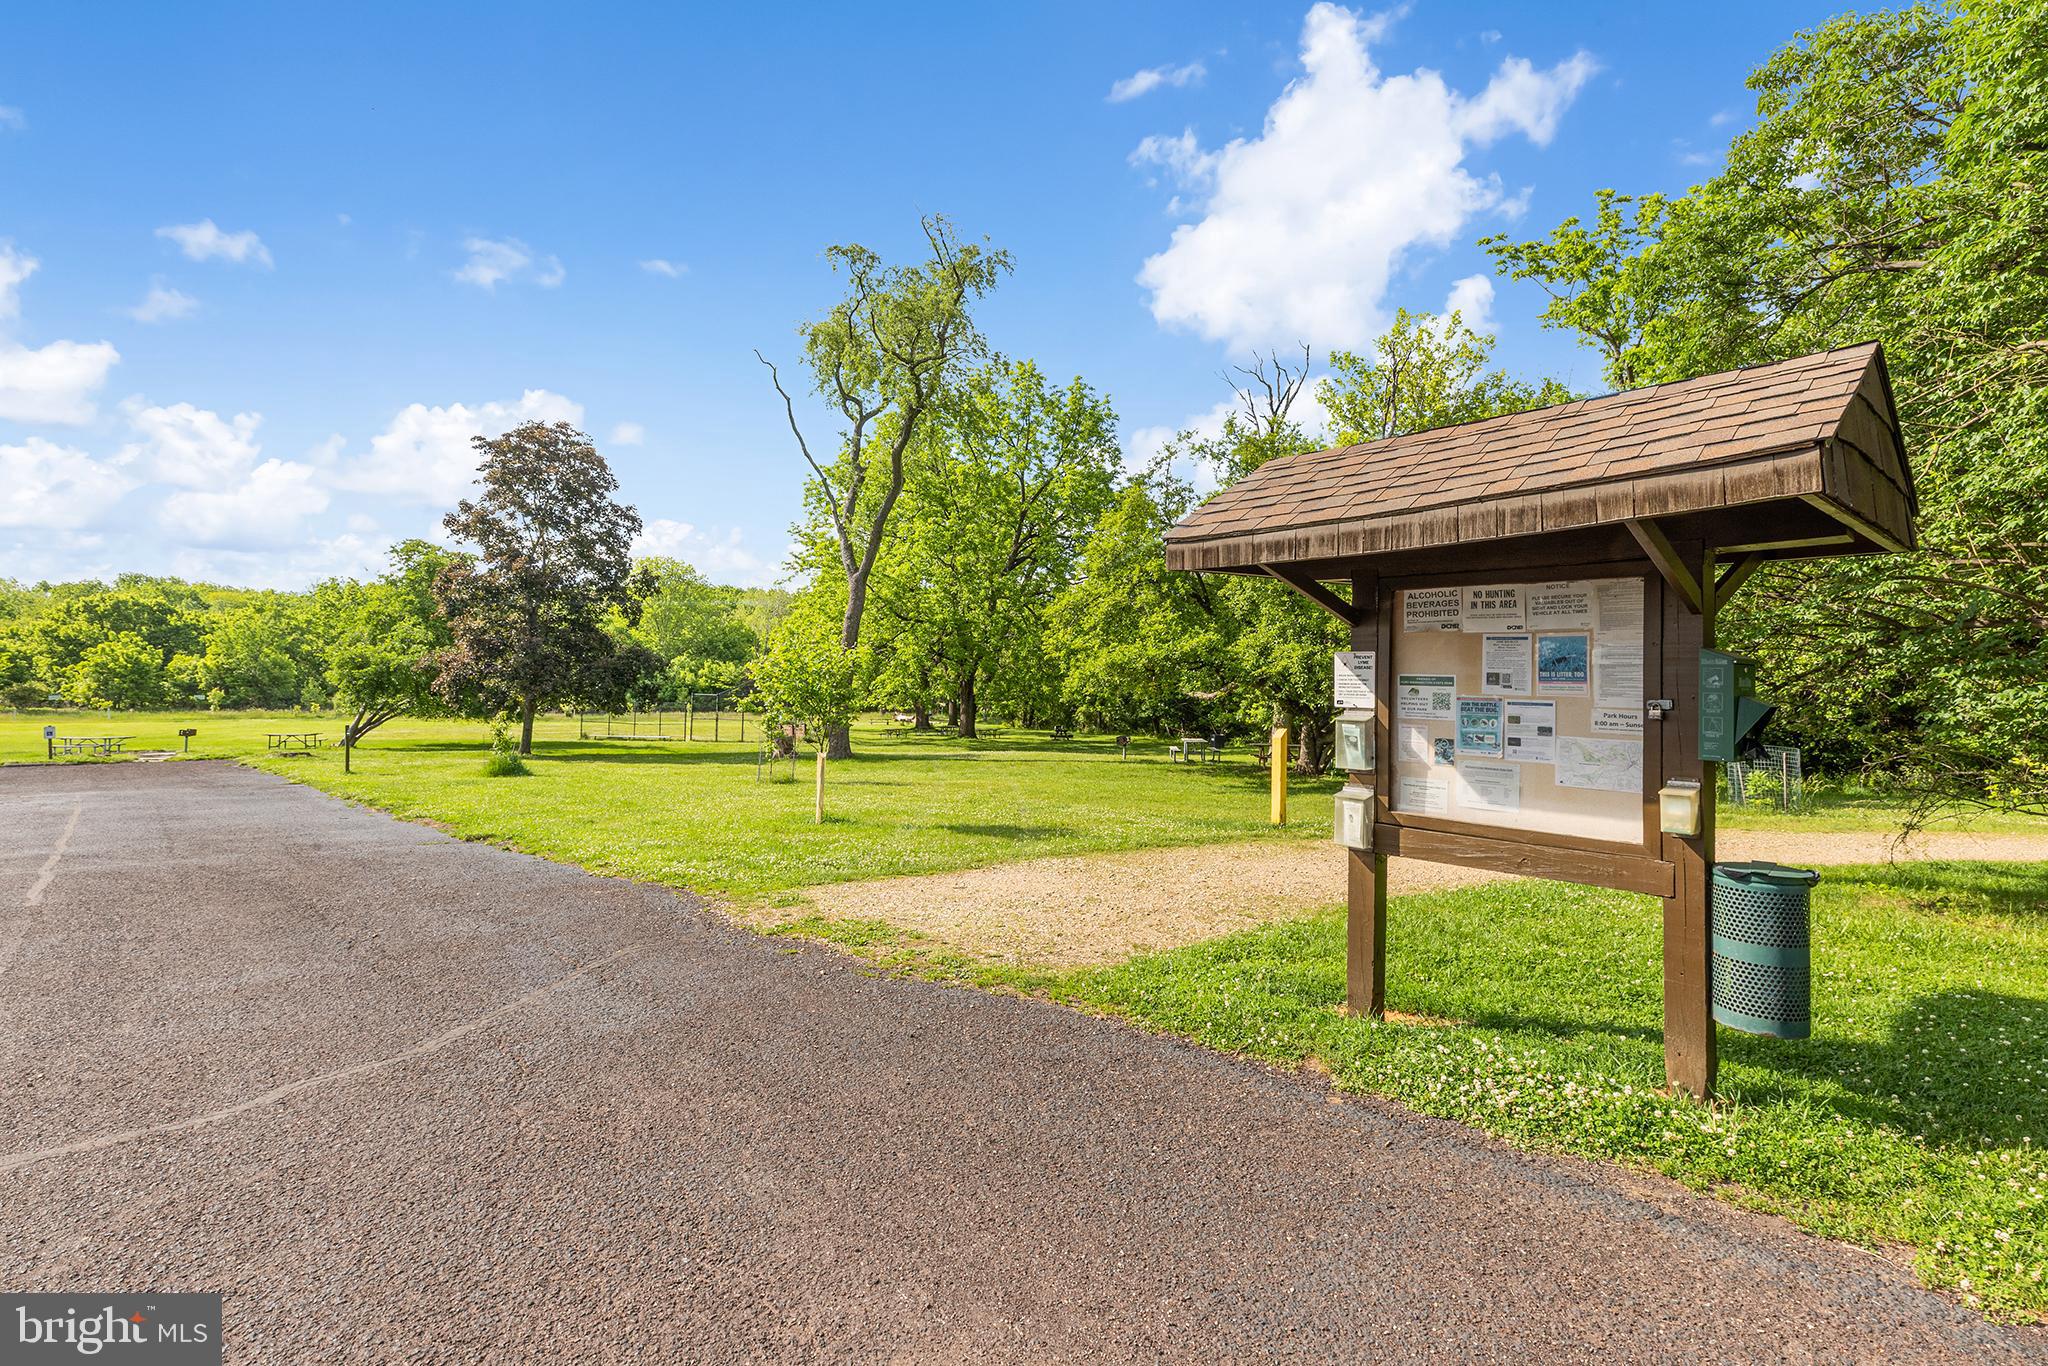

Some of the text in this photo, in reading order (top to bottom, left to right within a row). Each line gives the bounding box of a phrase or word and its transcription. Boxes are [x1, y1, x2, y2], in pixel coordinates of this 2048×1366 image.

[1408, 590, 1458, 600] ALCOHOLIC
[1473, 589, 1515, 599] NO HUNTING
[1406, 599, 1459, 609] BEVERAGES
[1471, 600, 1517, 610] IN THIS AREA
[1406, 608, 1459, 619] PROHIBITED
